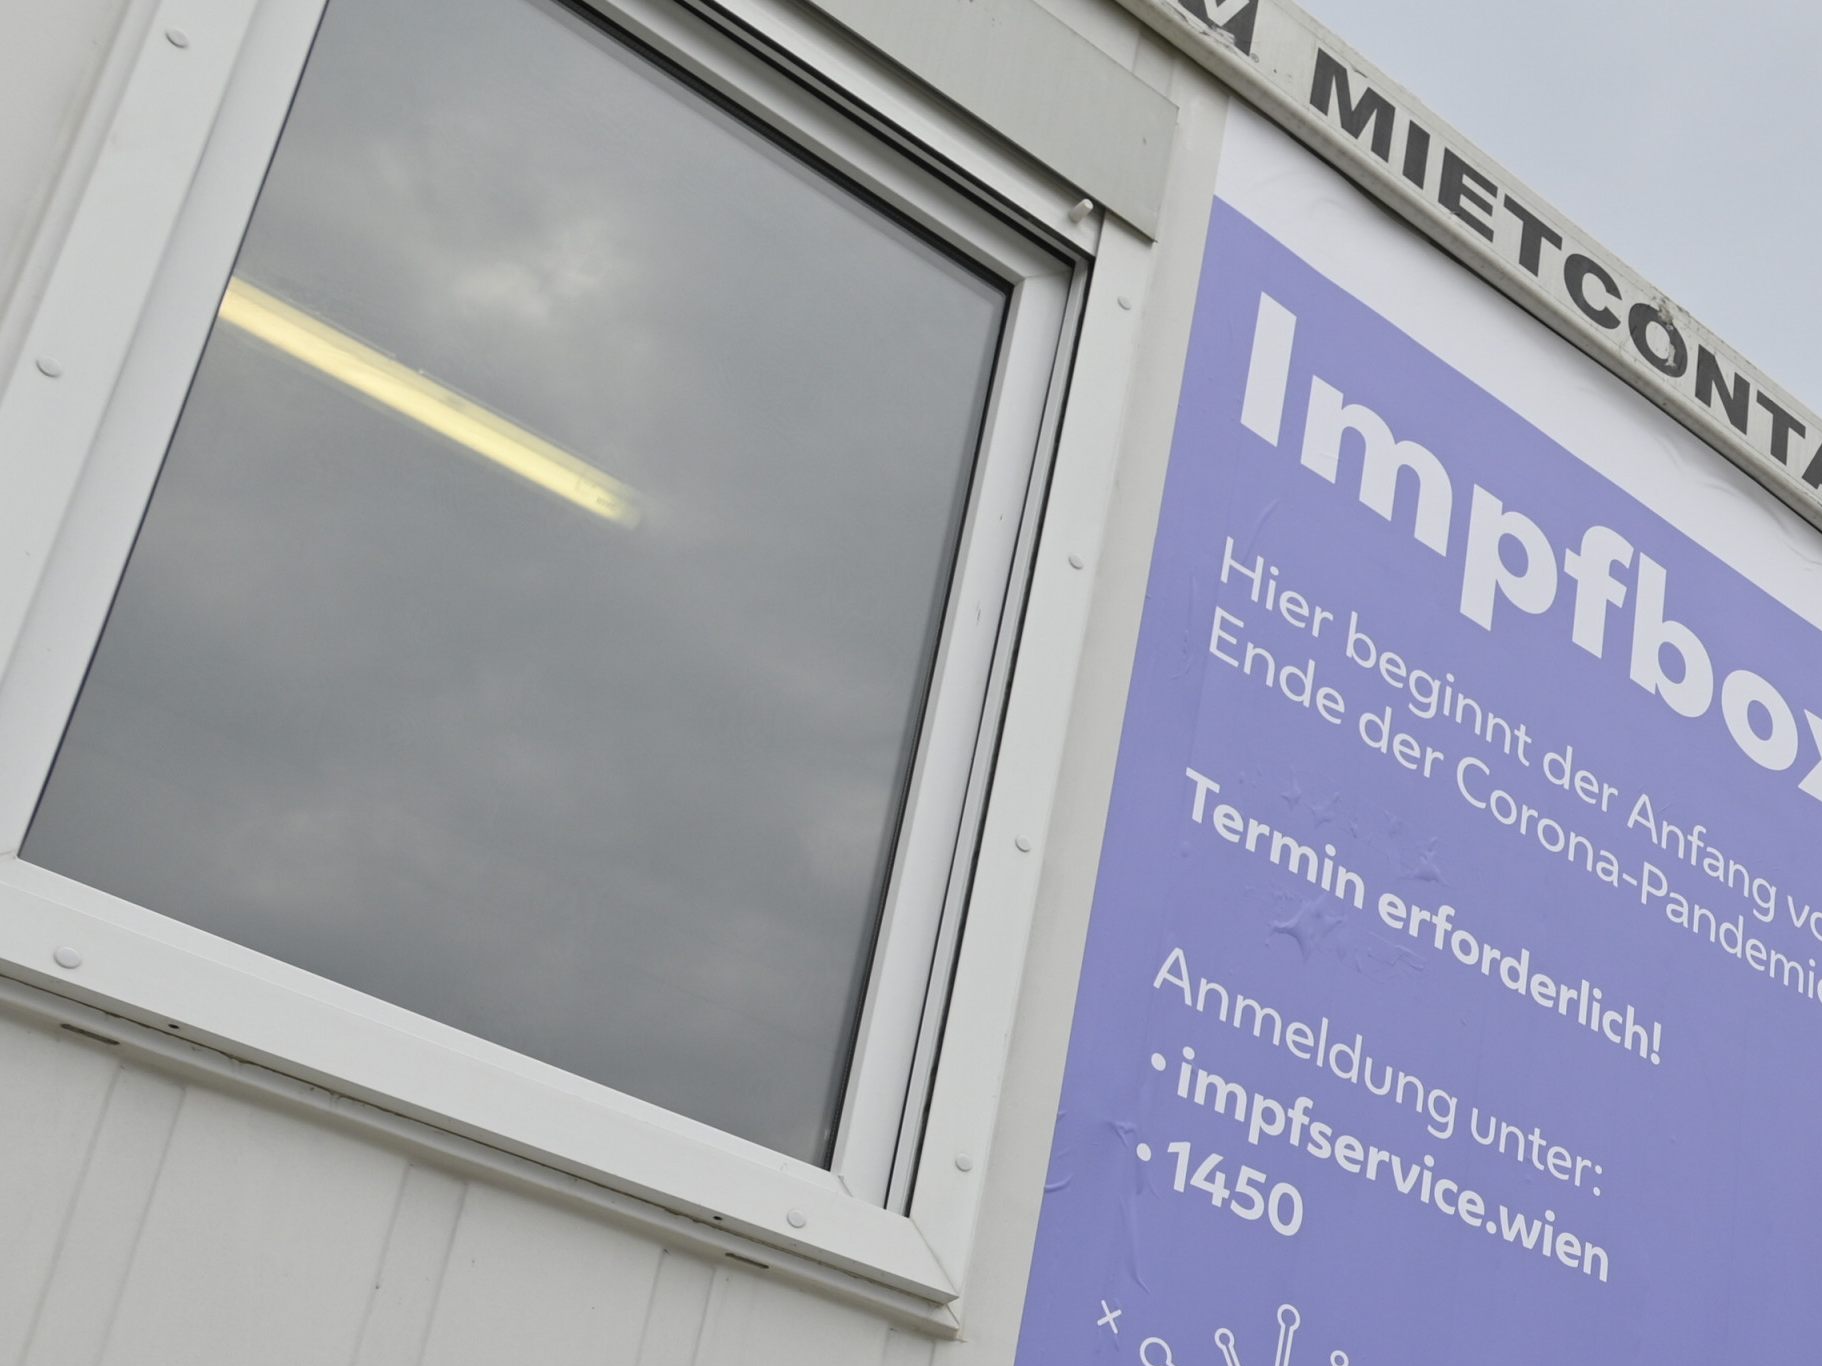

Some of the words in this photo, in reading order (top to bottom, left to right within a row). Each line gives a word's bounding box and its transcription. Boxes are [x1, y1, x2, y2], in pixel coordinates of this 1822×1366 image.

[1209, 605, 1346, 725] Ende
[1358, 705, 1444, 778] der
[1220, 535, 1334, 638] Hier
[1345, 610, 1532, 767] beginnt
[1542, 745, 1618, 812] der
[1626, 793, 1777, 922] Anfang
[1185, 767, 1366, 910] Termin
[1377, 890, 1663, 1065] erforderlich!
[1152, 947, 1458, 1139] Anmeldung
[1470, 1106, 1604, 1197] unter:
[1166, 1140, 1305, 1237] 1450
[1176, 1046, 1610, 1283] impfservice.wien
